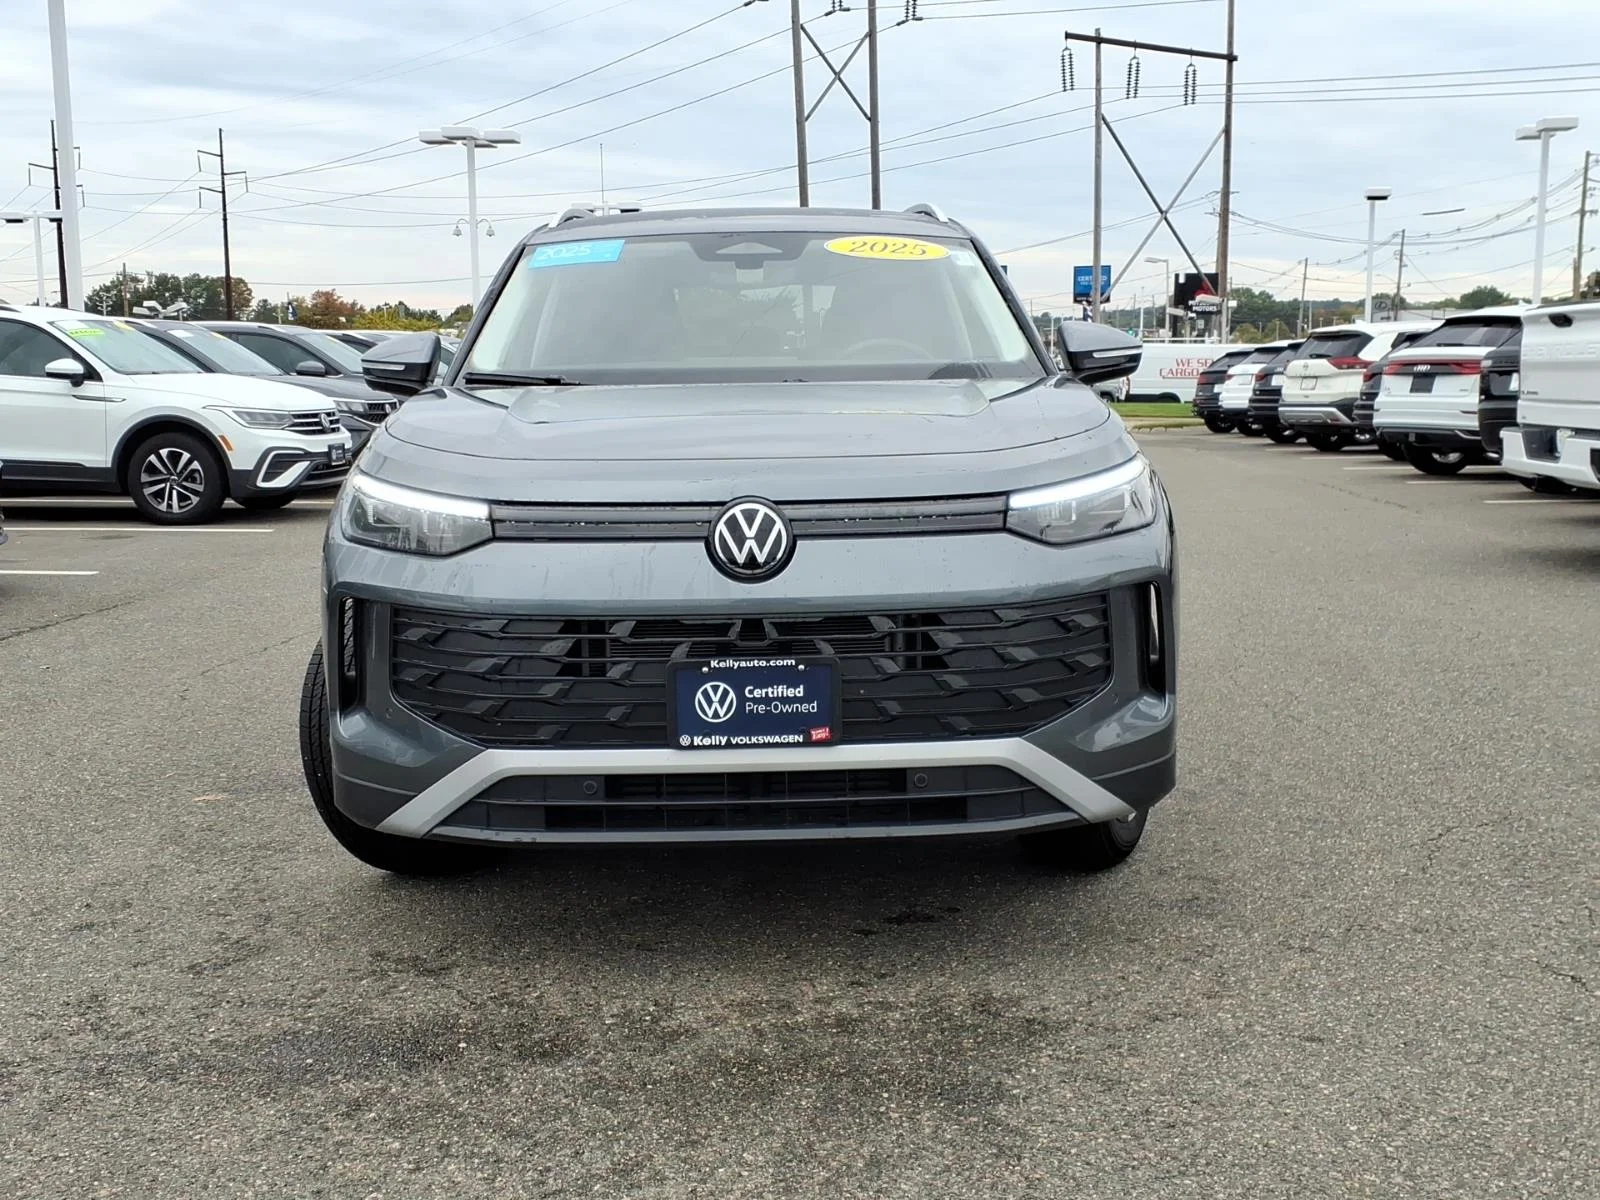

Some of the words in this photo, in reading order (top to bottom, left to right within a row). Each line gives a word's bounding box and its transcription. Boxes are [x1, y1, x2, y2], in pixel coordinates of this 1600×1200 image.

[849, 240, 929, 256] 2025
[1175, 358, 1194, 368] WE
[1159, 367, 1200, 377] CARGO
[710, 659, 796, 670] Kellyauto.com
[744, 684, 804, 698] Certified
[745, 700, 818, 714] Pre-Owned
[693, 735, 728, 746] Kelly
[730, 734, 804, 745] VOLKSWAGEN
